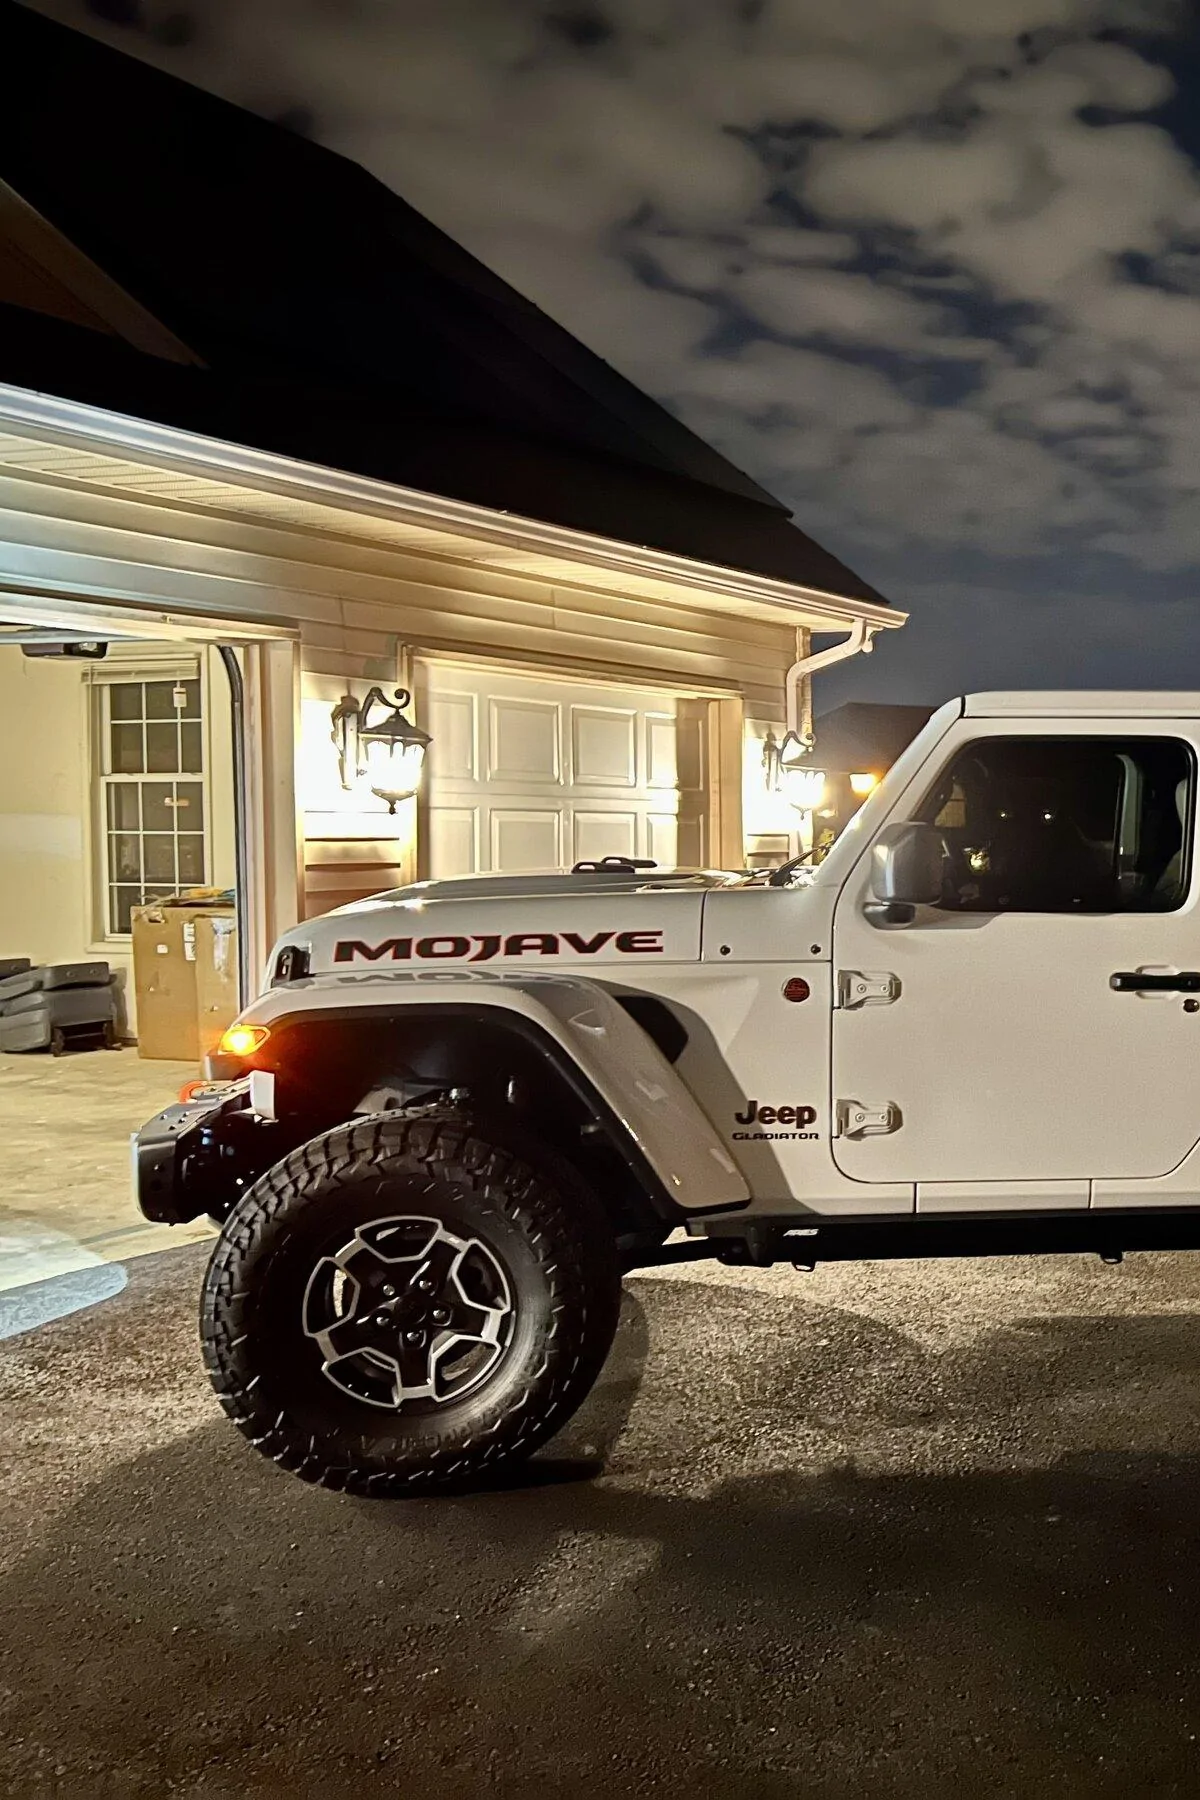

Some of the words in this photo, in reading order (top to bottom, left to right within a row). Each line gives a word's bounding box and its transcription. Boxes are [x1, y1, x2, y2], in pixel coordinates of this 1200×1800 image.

[334, 931, 663, 962] MOJAVE
[735, 1100, 817, 1129] Jeep
[732, 1132, 819, 1140] GLADIATOR
